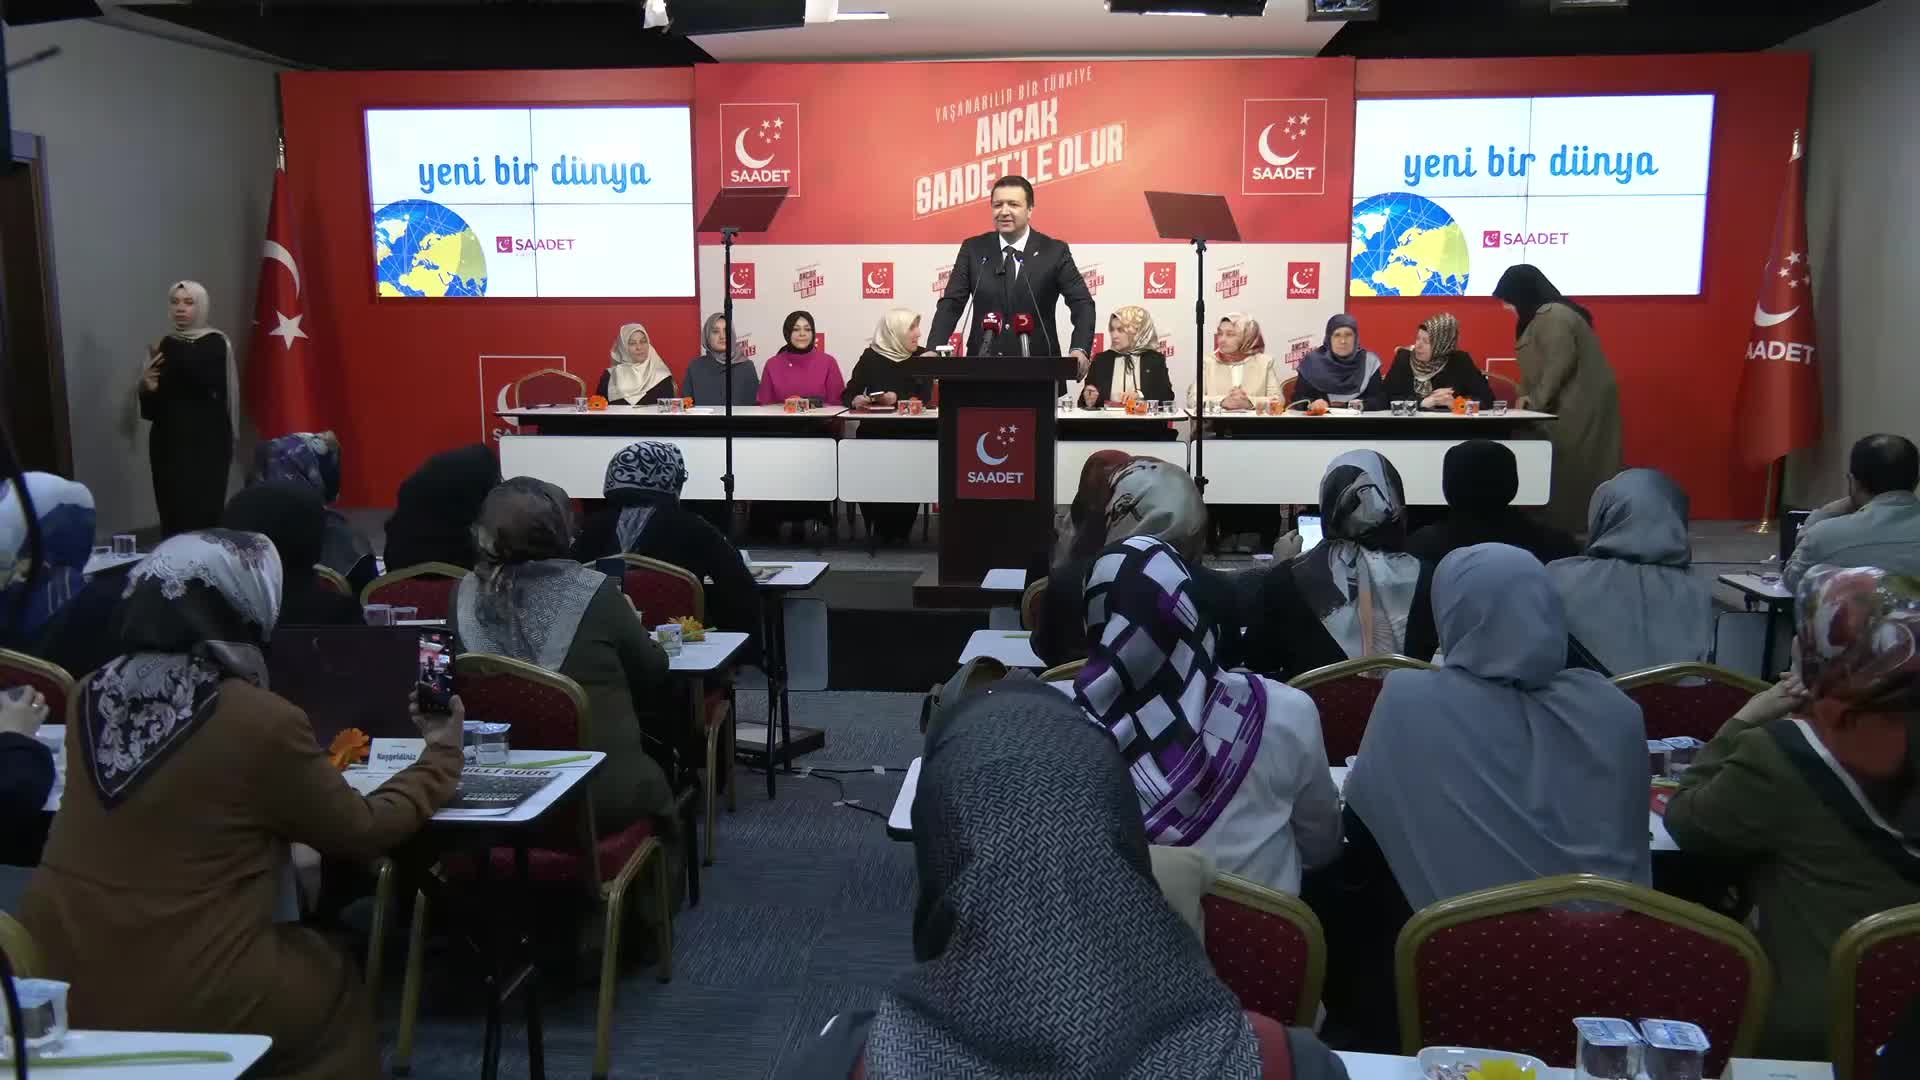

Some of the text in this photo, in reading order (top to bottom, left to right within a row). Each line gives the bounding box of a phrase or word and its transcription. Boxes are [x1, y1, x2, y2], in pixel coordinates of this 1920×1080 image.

[975, 97, 1059, 156] ANCAK
[1058, 124, 1124, 177] OLUR
[1404, 144, 1659, 187] yeni bir dünya
[419, 154, 652, 194] yeni bir dünya
[730, 169, 791, 183] SAADET
[1252, 166, 1316, 180] SAADET
[515, 238, 576, 251] SAADET
[1503, 232, 1568, 246] SAADET
[865, 287, 891, 295] SAADET
[1146, 287, 1173, 295] SAADET
[1289, 287, 1316, 295] SAADET
[1744, 340, 1815, 365] AADET
[967, 471, 1024, 484] SAADET
